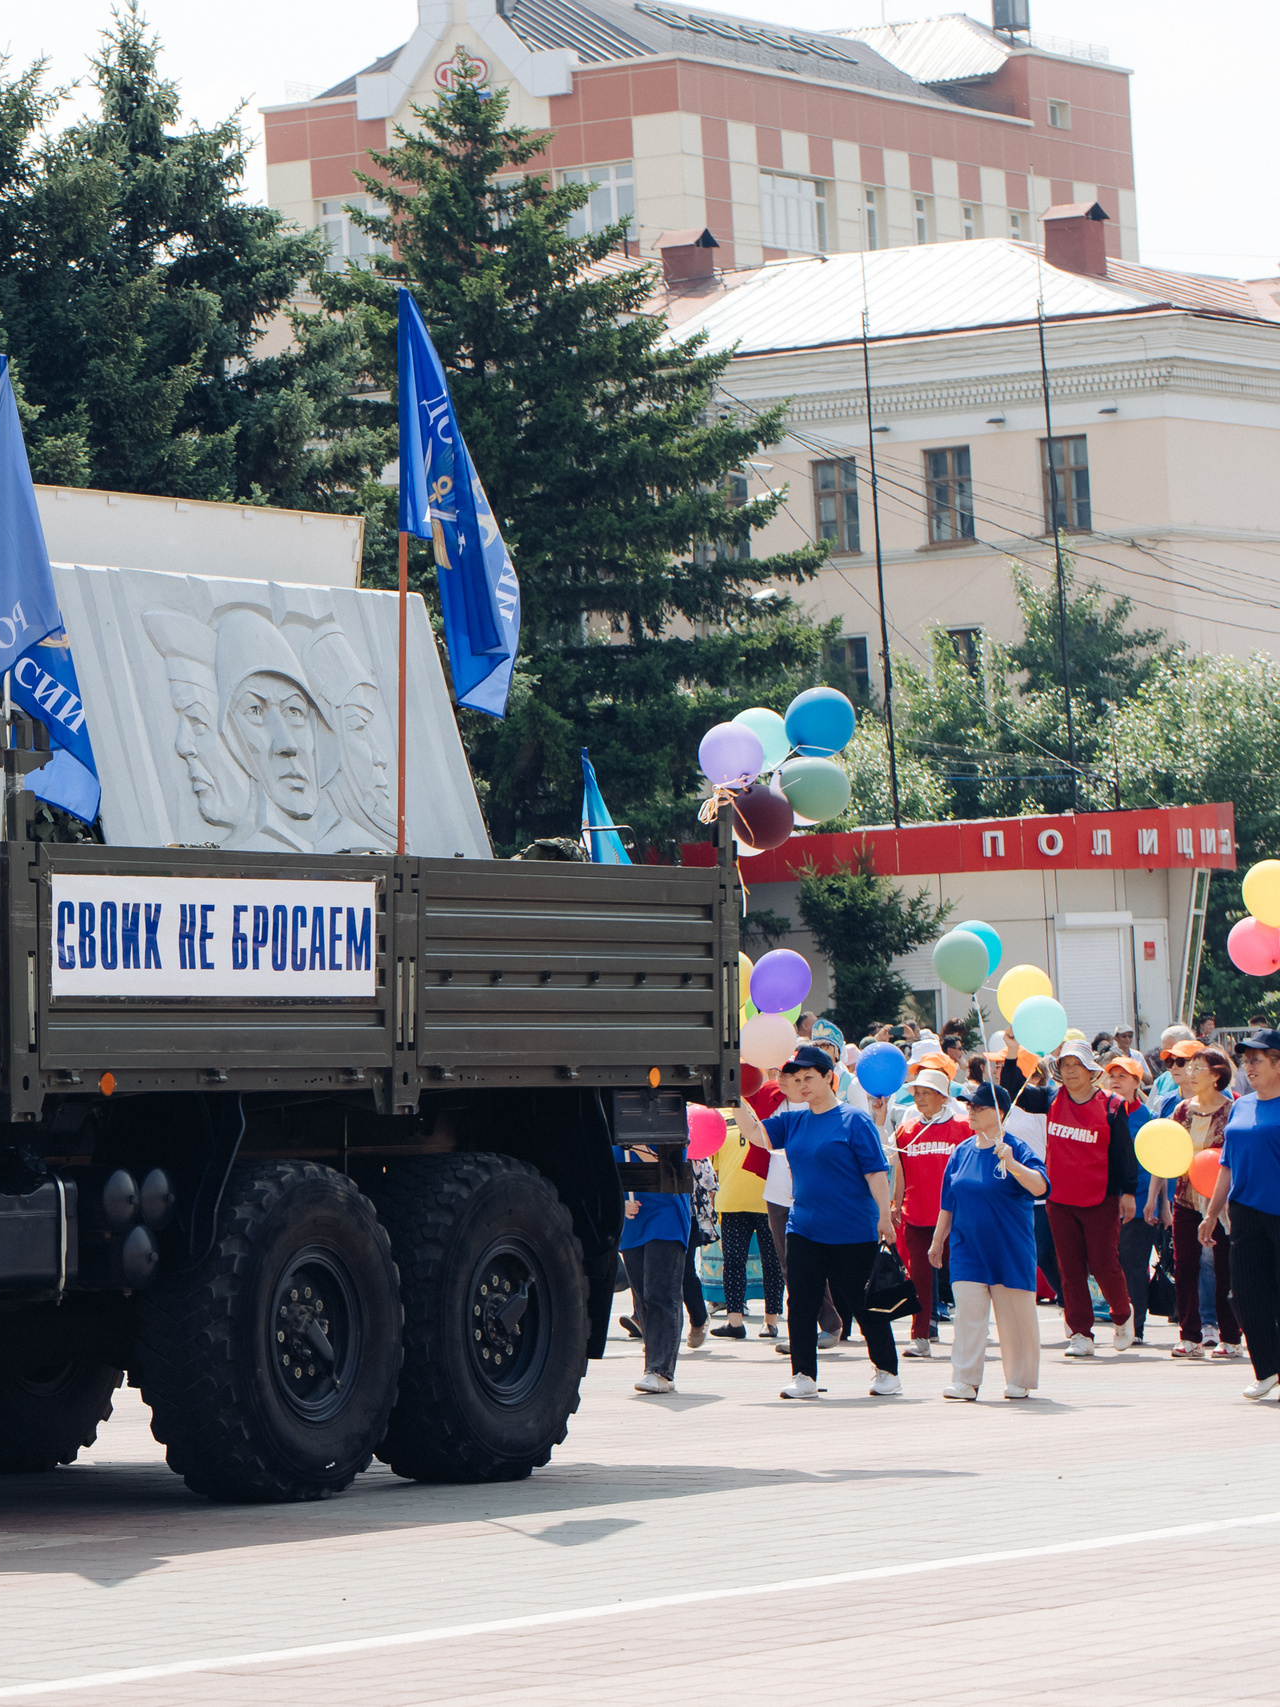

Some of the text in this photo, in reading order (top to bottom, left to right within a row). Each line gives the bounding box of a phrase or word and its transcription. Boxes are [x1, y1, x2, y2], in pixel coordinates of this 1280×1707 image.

[982, 828, 1233, 859] ПОЛИЦИЯ
[57, 901, 371, 972] СВОИХ НЕ БРОСАЕМ
